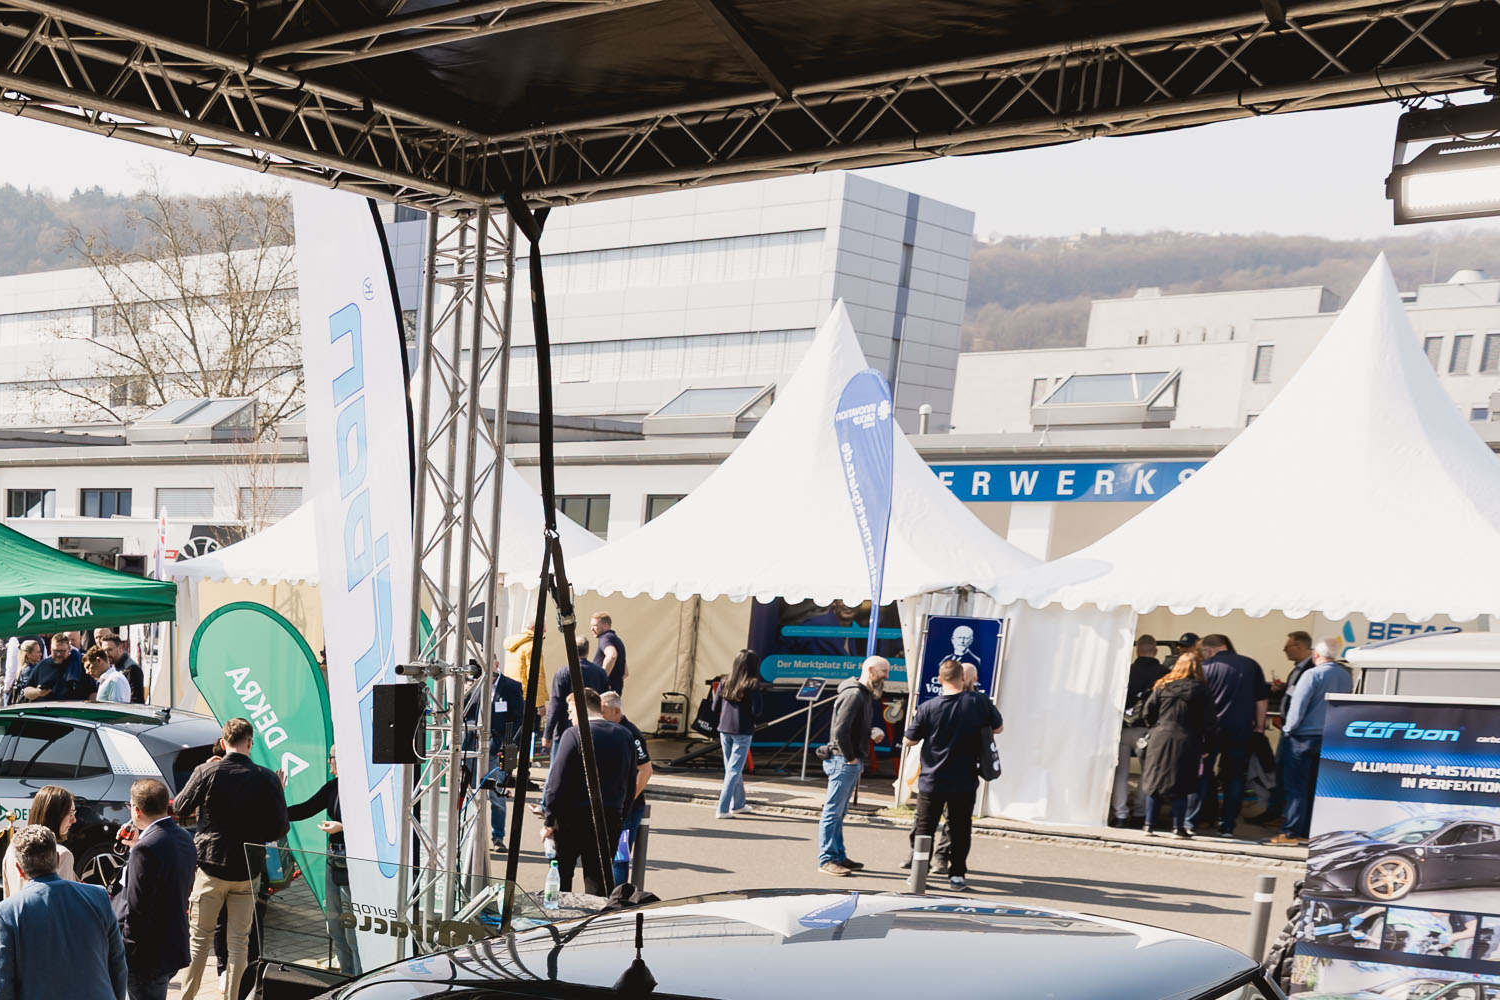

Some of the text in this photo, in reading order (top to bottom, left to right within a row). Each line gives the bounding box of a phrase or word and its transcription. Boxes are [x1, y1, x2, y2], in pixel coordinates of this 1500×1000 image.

[41, 596, 93, 620] DEKRA
[776, 659, 792, 669] Der
[793, 660, 841, 671] Marktplatz
[843, 661, 856, 671] für
[1345, 720, 1461, 742] carbon
[1401, 777, 1416, 789] IN
